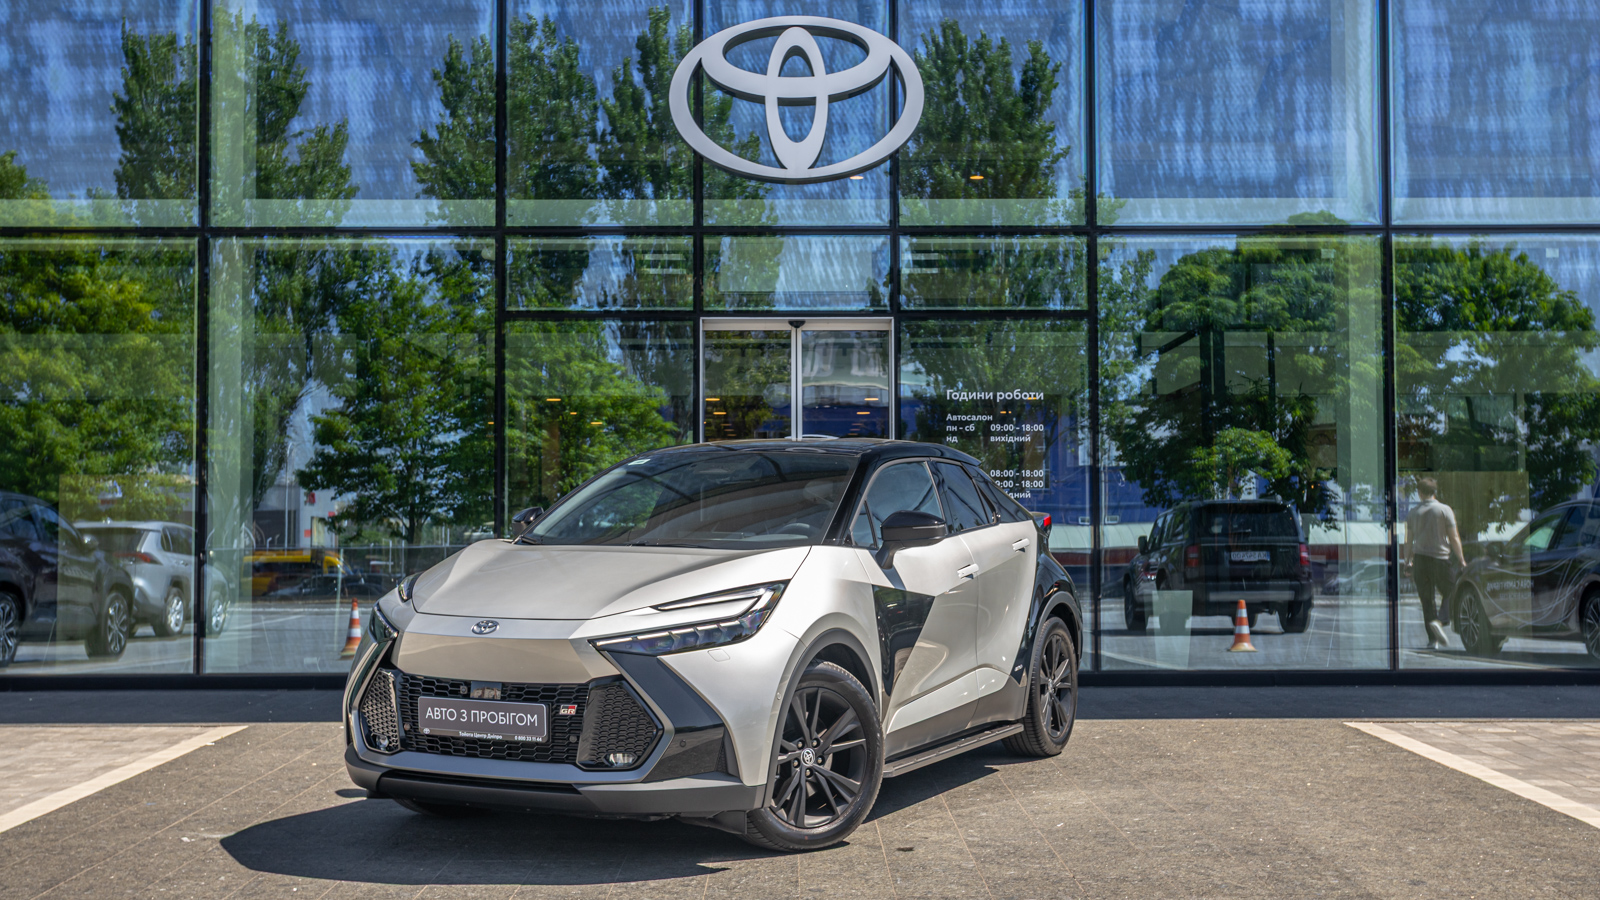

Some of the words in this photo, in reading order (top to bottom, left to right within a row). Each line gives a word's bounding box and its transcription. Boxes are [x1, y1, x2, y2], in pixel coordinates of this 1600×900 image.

[946, 390, 993, 401] Години
[996, 388, 1044, 402] роботи
[946, 413, 993, 421] Автосалон
[964, 424, 975, 432] сб
[990, 424, 1014, 432] 09:00
[1021, 424, 1044, 432] 18:00
[990, 435, 1031, 443] вихідний
[990, 469, 1014, 477] 08:00
[1021, 469, 1044, 477] 18:00
[995, 480, 1014, 488] 9:00
[1021, 480, 1044, 488] 18:00
[425, 706, 457, 722] АВТО
[459, 709, 468, 722] З
[470, 710, 538, 727] ПРОБІГОМ
